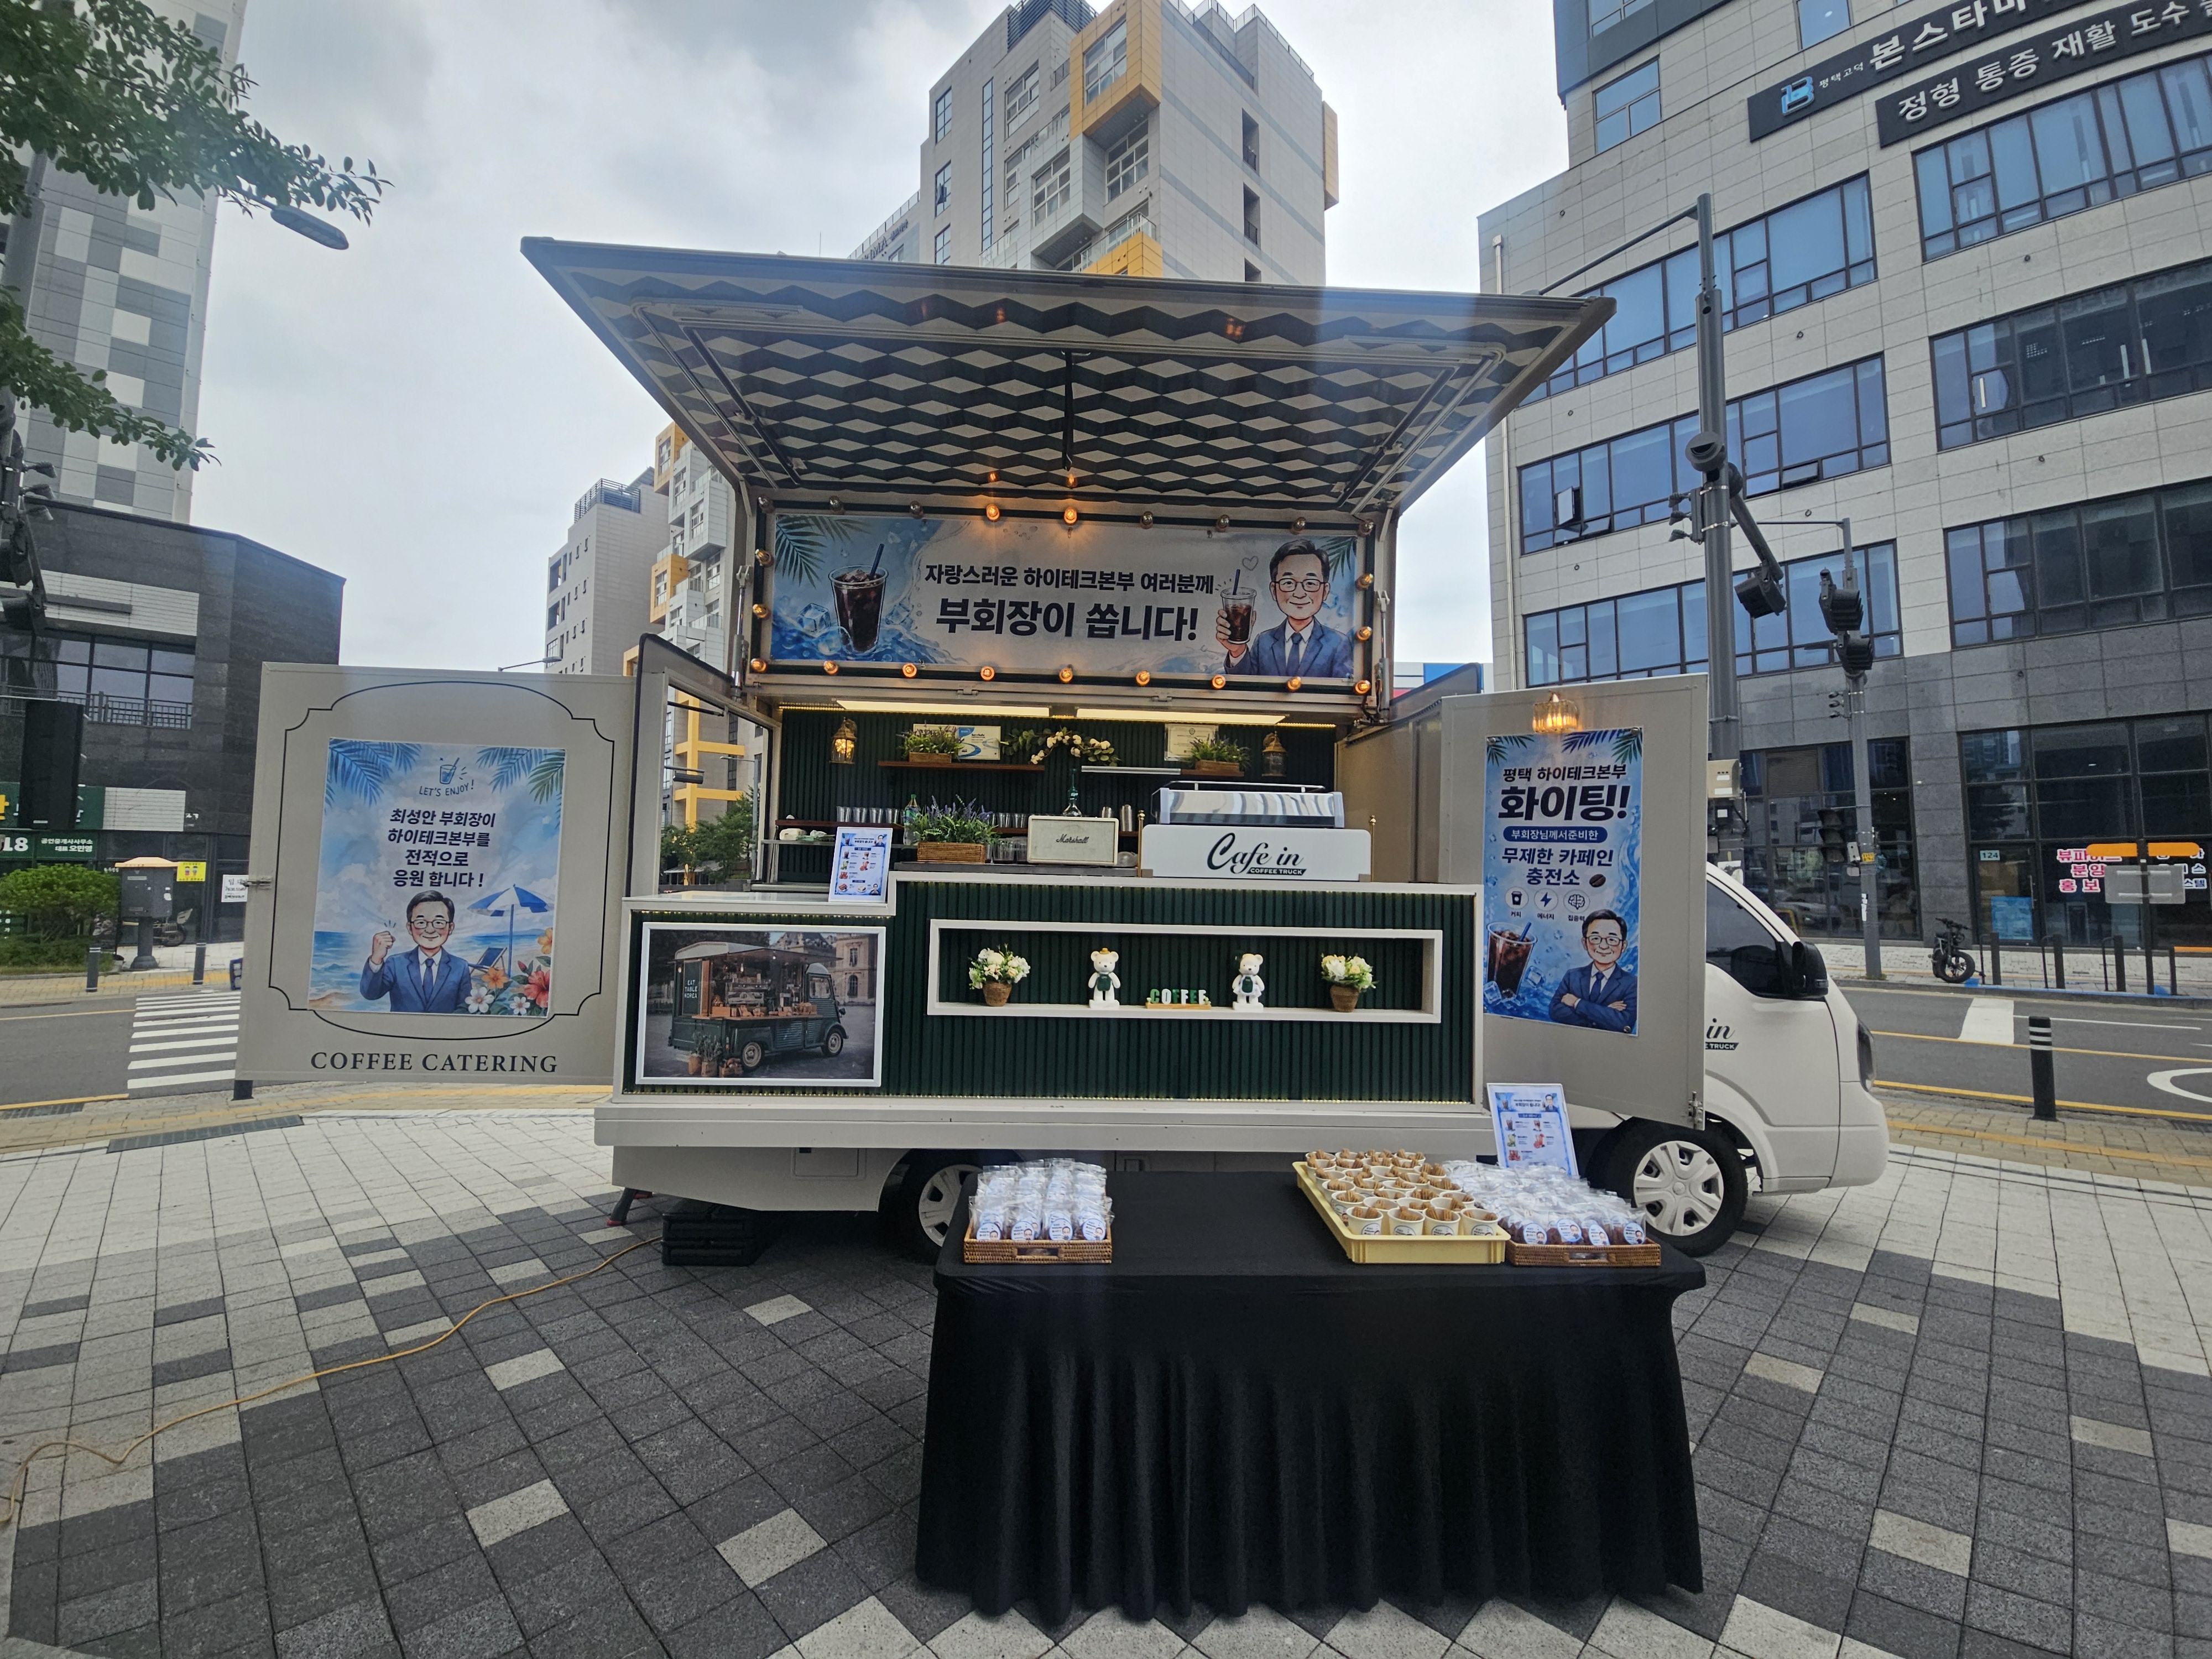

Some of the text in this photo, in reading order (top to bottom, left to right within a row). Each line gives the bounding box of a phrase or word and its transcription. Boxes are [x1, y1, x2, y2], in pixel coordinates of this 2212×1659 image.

[1898, 77, 1960, 122] 정형
[1975, 48, 2039, 92] 통증
[2051, 20, 2117, 59] 재활
[2131, 1, 2190, 36] 도수
[925, 564, 1214, 594] 자랑스러운 하이테크본부 여러분께
[936, 597, 1198, 641] 부회장이 쏩니다!
[1503, 764, 1627, 782] 평택 하이테크본부
[419, 779, 474, 797] LET'S ENJOY!
[1498, 785, 1631, 821] 화이팅!
[390, 808, 496, 827] 최성안 부회장이
[388, 828, 491, 847] 하이테크본부를
[1511, 829, 1599, 841] 부회장님께서준비한
[405, 849, 468, 867] 전적으로
[1207, 832, 1304, 874] Cafe in
[1502, 848, 1614, 867] 무제한 카페인
[393, 869, 424, 886] 응원
[429, 872, 474, 887] 합니다
[1526, 867, 1580, 885] 충전소
[1706, 1018, 1735, 1040] in
[310, 1052, 557, 1072] COFFEE CATERING
